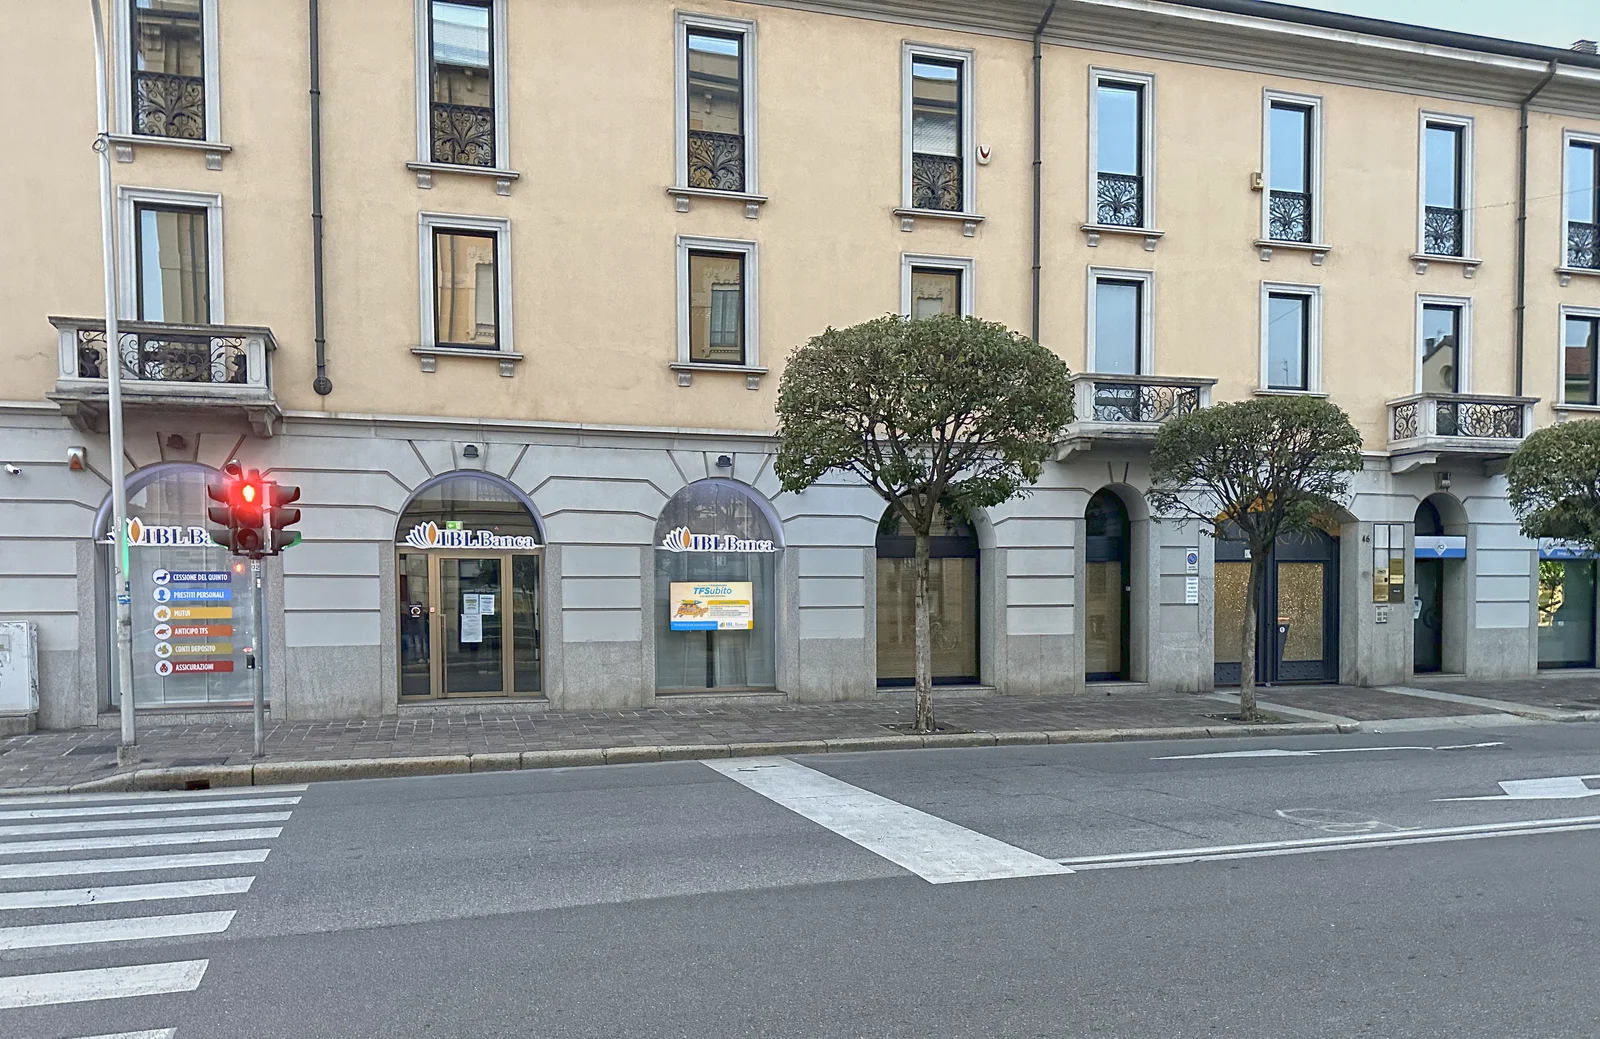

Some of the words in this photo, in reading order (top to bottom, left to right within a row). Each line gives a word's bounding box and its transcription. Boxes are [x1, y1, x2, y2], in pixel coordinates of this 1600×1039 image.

[143, 527, 187, 547] IBL
[439, 531, 476, 549] IBL
[478, 531, 536, 550] Banca
[1362, 534, 1371, 543] 46
[692, 535, 724, 552] IBL
[725, 536, 776, 553] Banca
[693, 586, 733, 595] TFSubito
[173, 591, 196, 599] PRESTITI
[196, 591, 225, 599] PERSONALI
[173, 609, 191, 617] MUTUI
[174, 627, 198, 635] ANTICIPO
[199, 627, 208, 635] TFS
[175, 645, 190, 653] CONTI
[191, 645, 216, 653] DEPOSITO
[175, 663, 214, 671] ASSICURAZIONI
